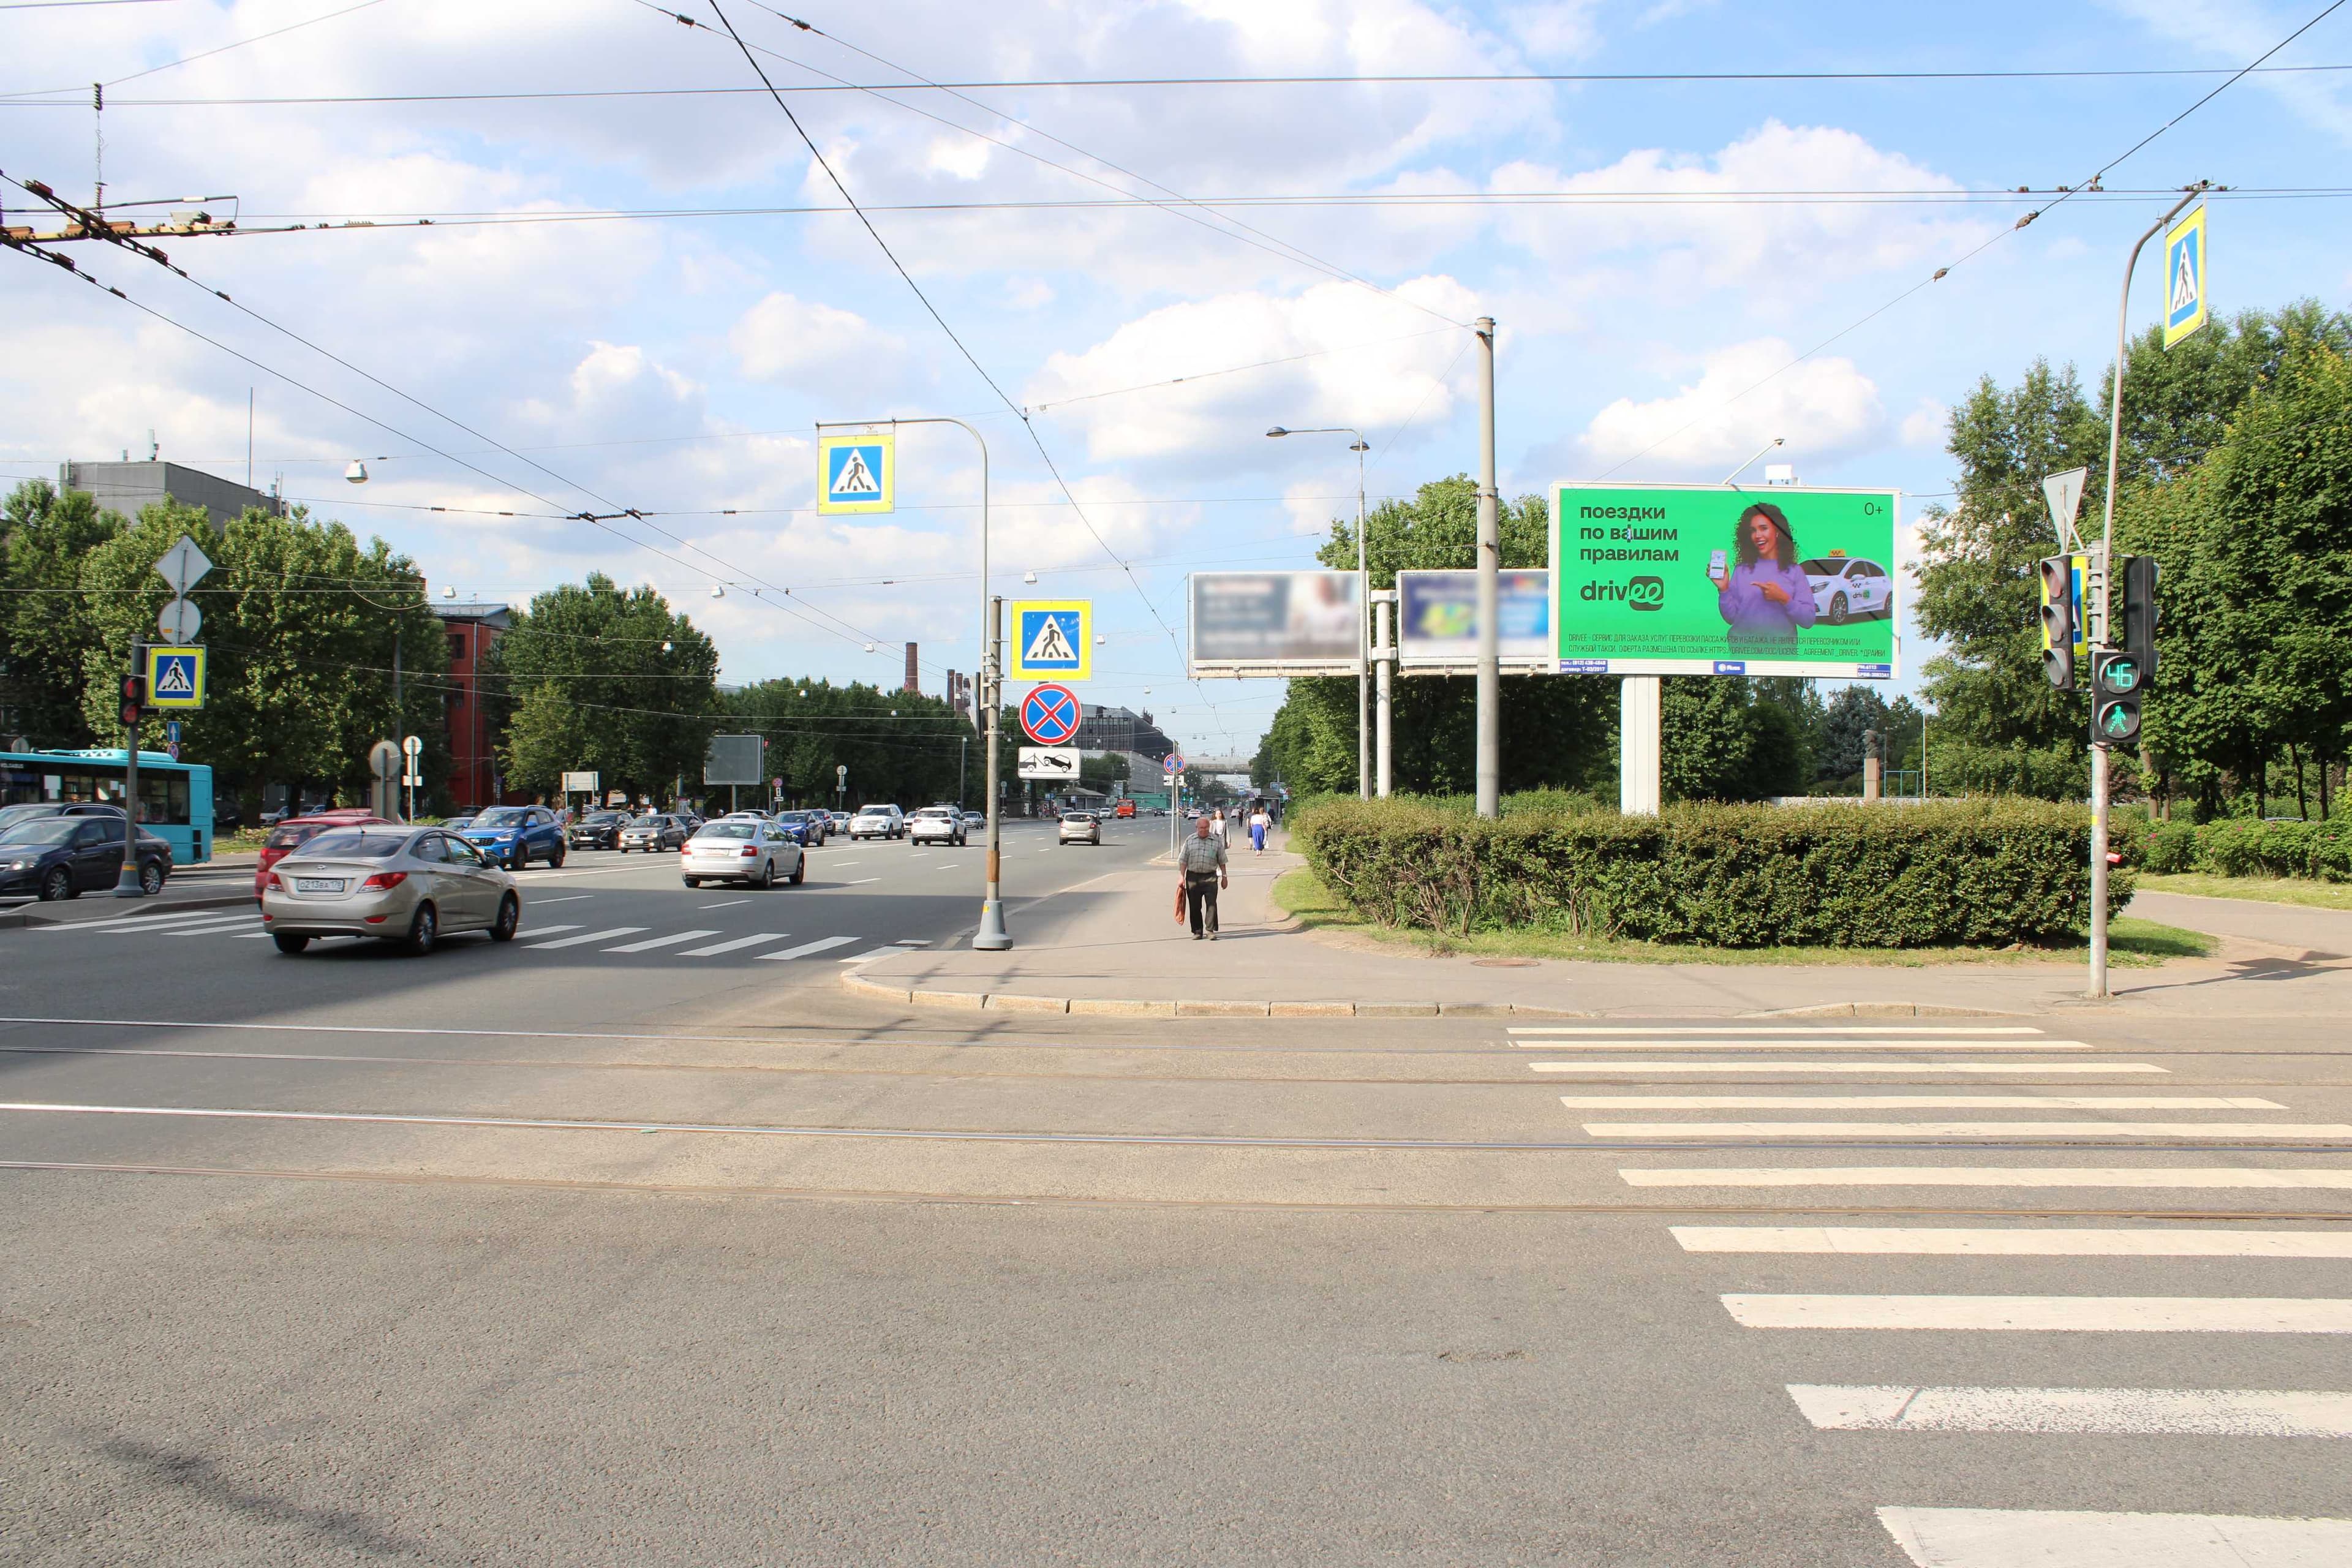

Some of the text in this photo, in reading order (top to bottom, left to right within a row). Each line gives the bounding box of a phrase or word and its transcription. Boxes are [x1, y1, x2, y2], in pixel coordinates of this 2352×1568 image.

[1580, 507, 1665, 522] поездки
[1864, 502, 1883, 515] 0+
[1580, 527, 1678, 541] по вашим
[1580, 548, 1679, 565] правилам
[1580, 579, 1664, 606] drivee
[1569, 633, 1587, 642] DRIVEE
[1592, 633, 1613, 642] СЕРВИС
[1613, 634, 1626, 643] ДЛЯ
[1626, 634, 1649, 643] ЗАКАЗА
[1669, 635, 1700, 643] ПЕРЕВОЗКИ
[1701, 635, 1738, 644] ПАССАЖИРОВ
[1806, 637, 1849, 646] ПЕРЕВОЗЧИКОМ
[1569, 644, 1596, 652] СЛУЖБОЙ
[1619, 644, 1641, 653] ОФЕРТА
[1642, 645, 1677, 654] РАЗМЕЩЕНА
[2107, 663, 2133, 687] 46
